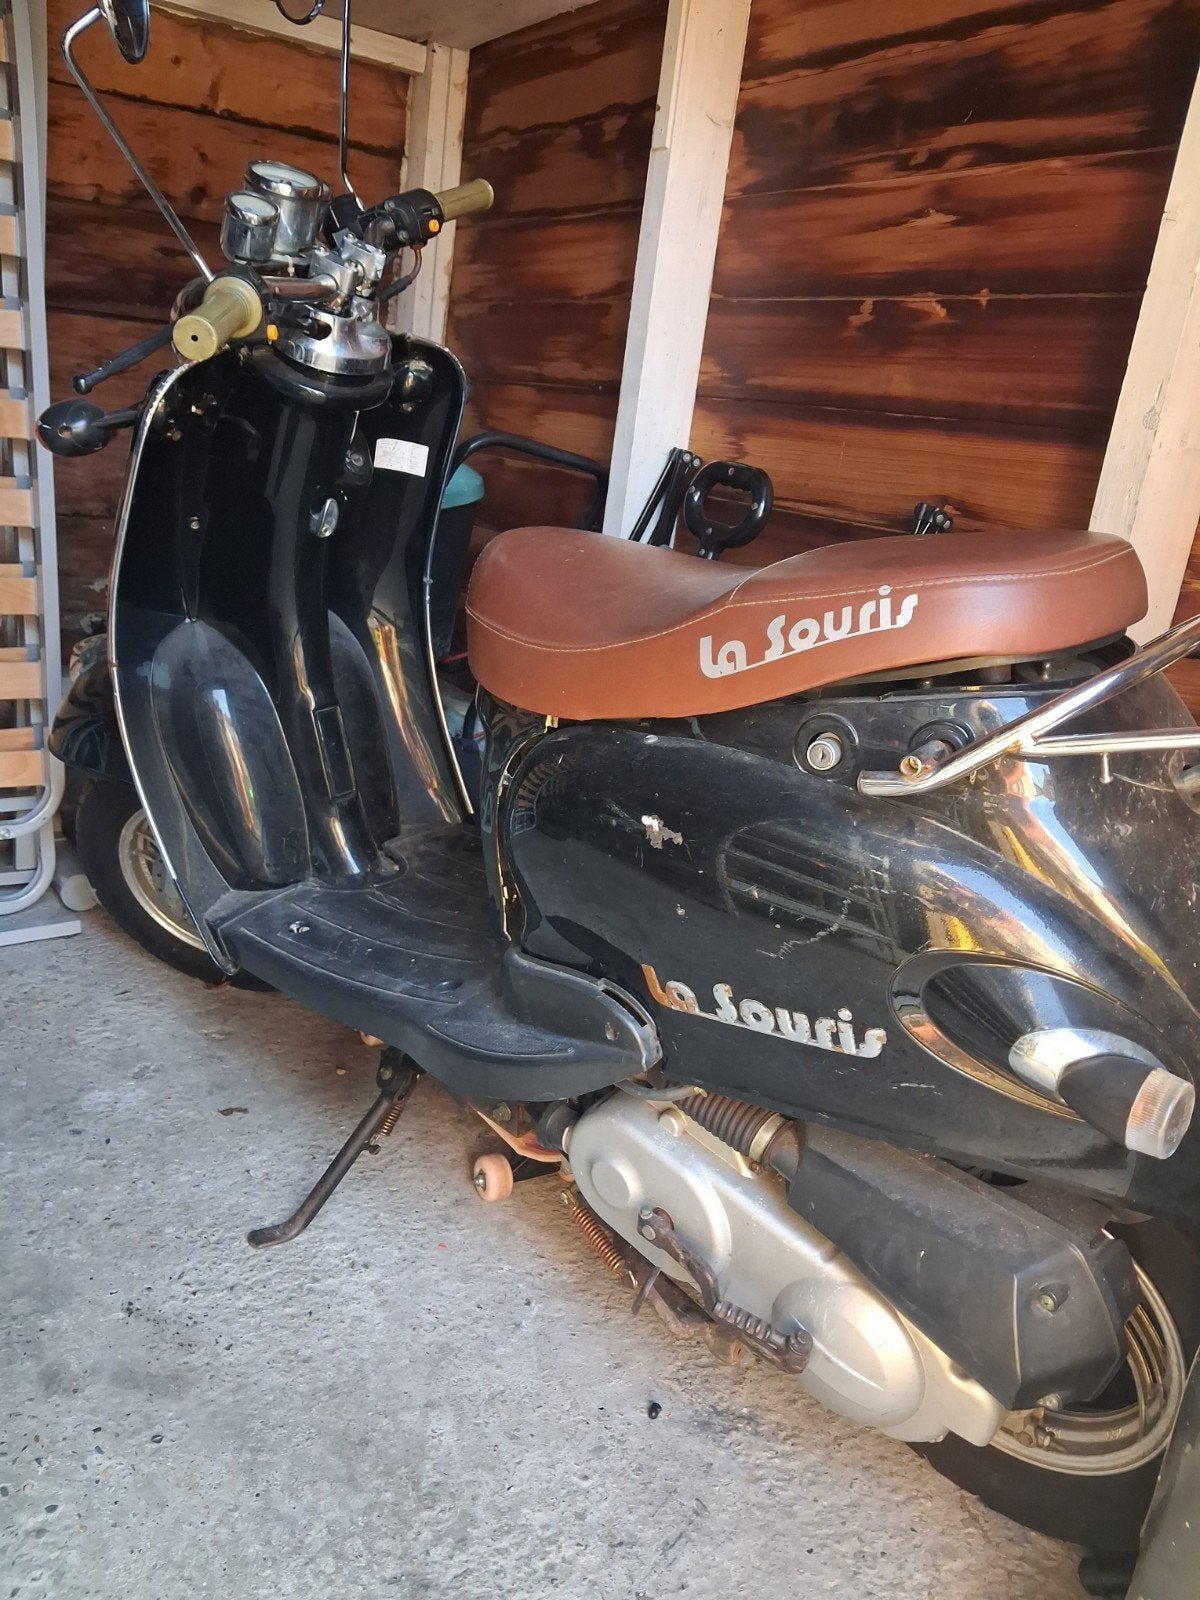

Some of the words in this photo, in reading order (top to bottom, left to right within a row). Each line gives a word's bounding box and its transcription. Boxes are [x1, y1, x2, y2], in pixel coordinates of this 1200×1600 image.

[765, 585, 918, 661] Souris
[641, 963, 700, 1014] La
[713, 983, 887, 1058] Souris
